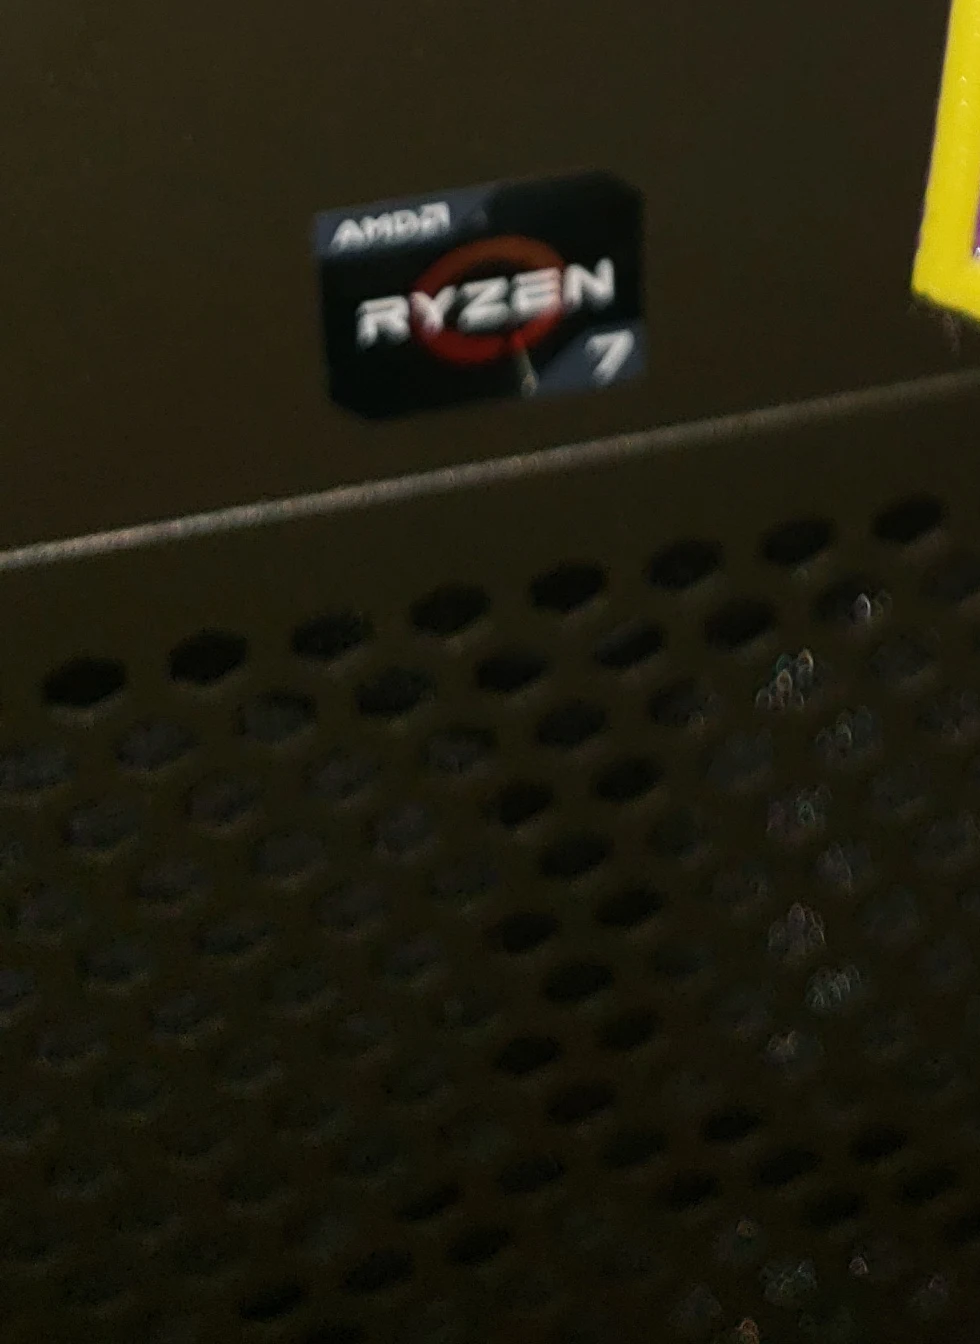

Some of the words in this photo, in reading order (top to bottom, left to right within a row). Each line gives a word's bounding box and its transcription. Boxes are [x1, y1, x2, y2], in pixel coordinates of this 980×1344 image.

[330, 209, 420, 255] AMD
[355, 257, 615, 350] RYZEN
[584, 327, 635, 387] 7
